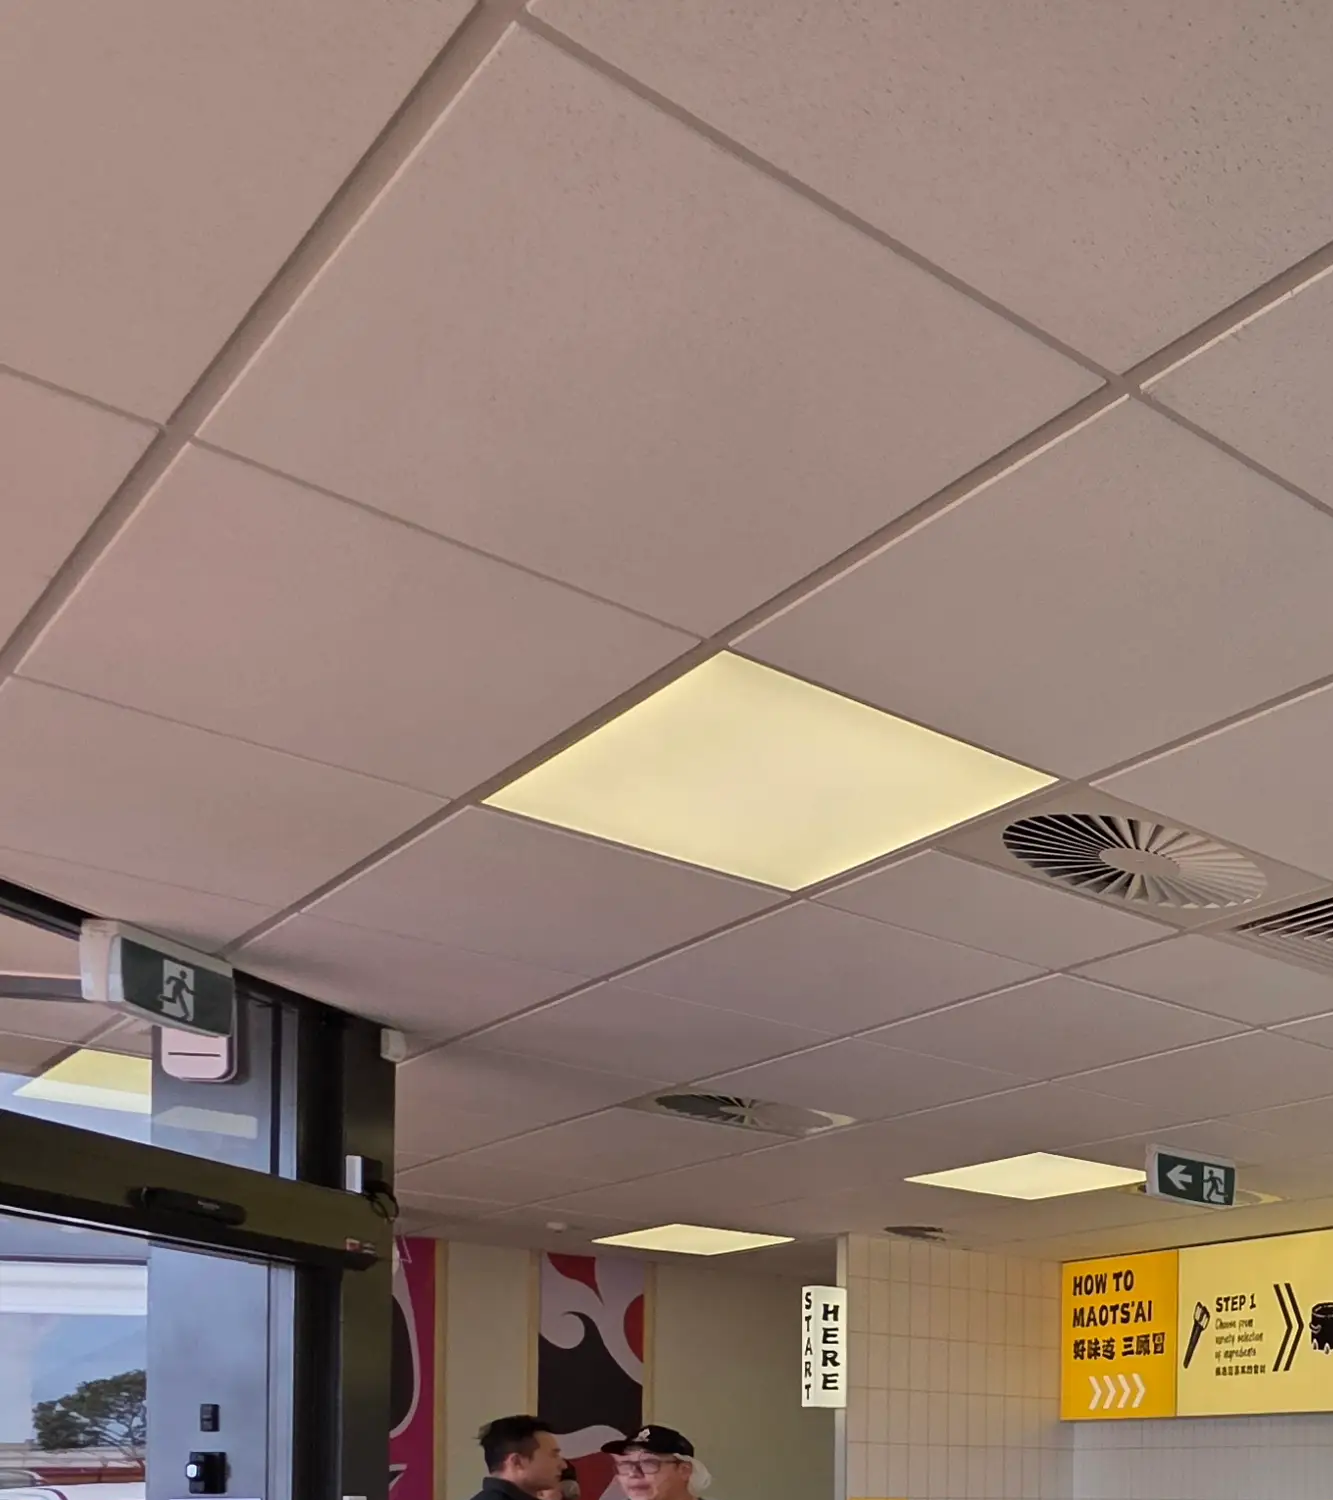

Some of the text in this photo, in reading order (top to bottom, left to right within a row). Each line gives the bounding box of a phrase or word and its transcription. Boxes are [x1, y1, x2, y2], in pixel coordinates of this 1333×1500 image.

[1073, 1270, 1134, 1296] HOW TO
[1072, 1300, 1152, 1328] MAOTS'AI
[1216, 1294, 1256, 1312] STEP 1
[804, 1292, 812, 1400] START
[822, 1304, 840, 1390] HERE
